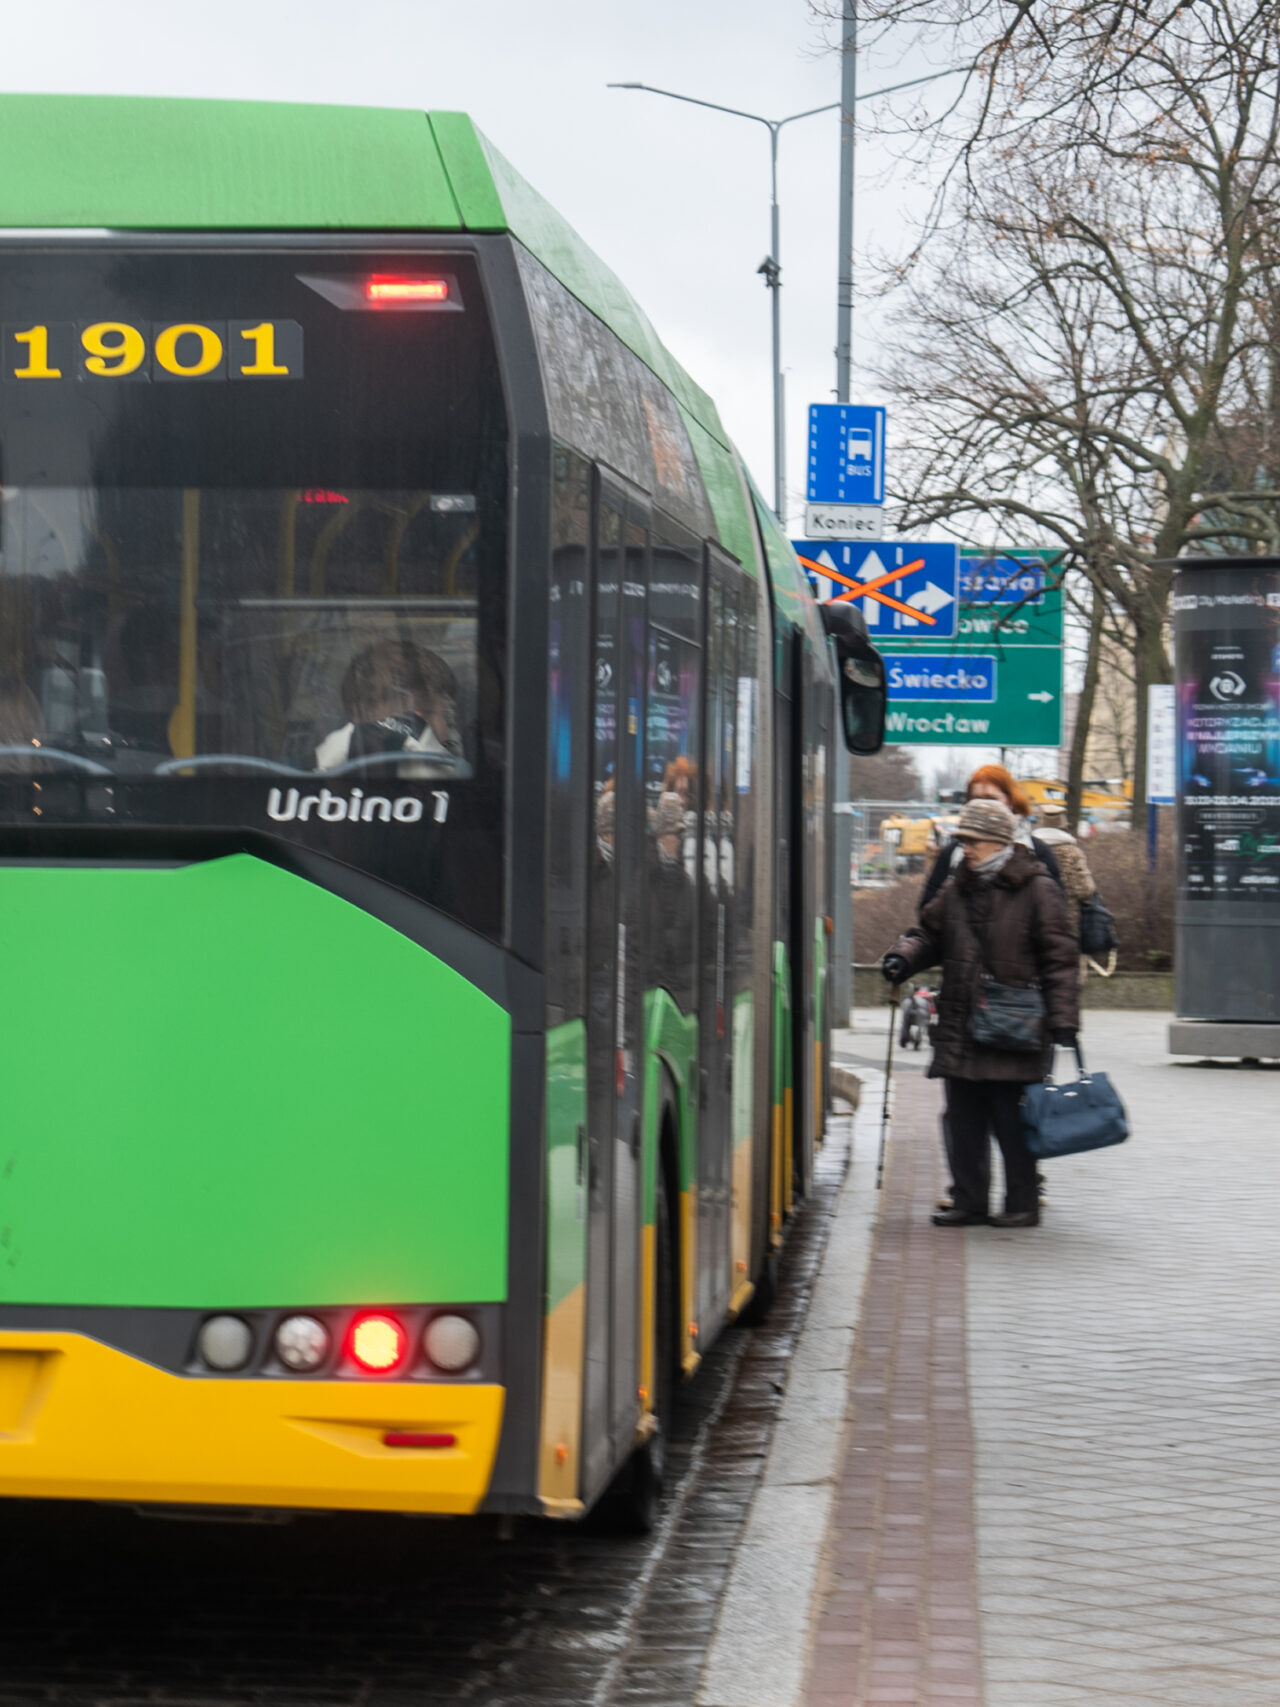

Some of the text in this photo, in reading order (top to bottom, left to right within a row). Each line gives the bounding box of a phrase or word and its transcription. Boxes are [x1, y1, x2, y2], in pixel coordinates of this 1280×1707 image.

[14, 321, 289, 378] 1901
[846, 464, 872, 477] BUS
[813, 513, 875, 532] Koniec
[887, 661, 988, 690] Świecko
[884, 712, 990, 733] Wrocław
[267, 787, 450, 823] Urbino 1
